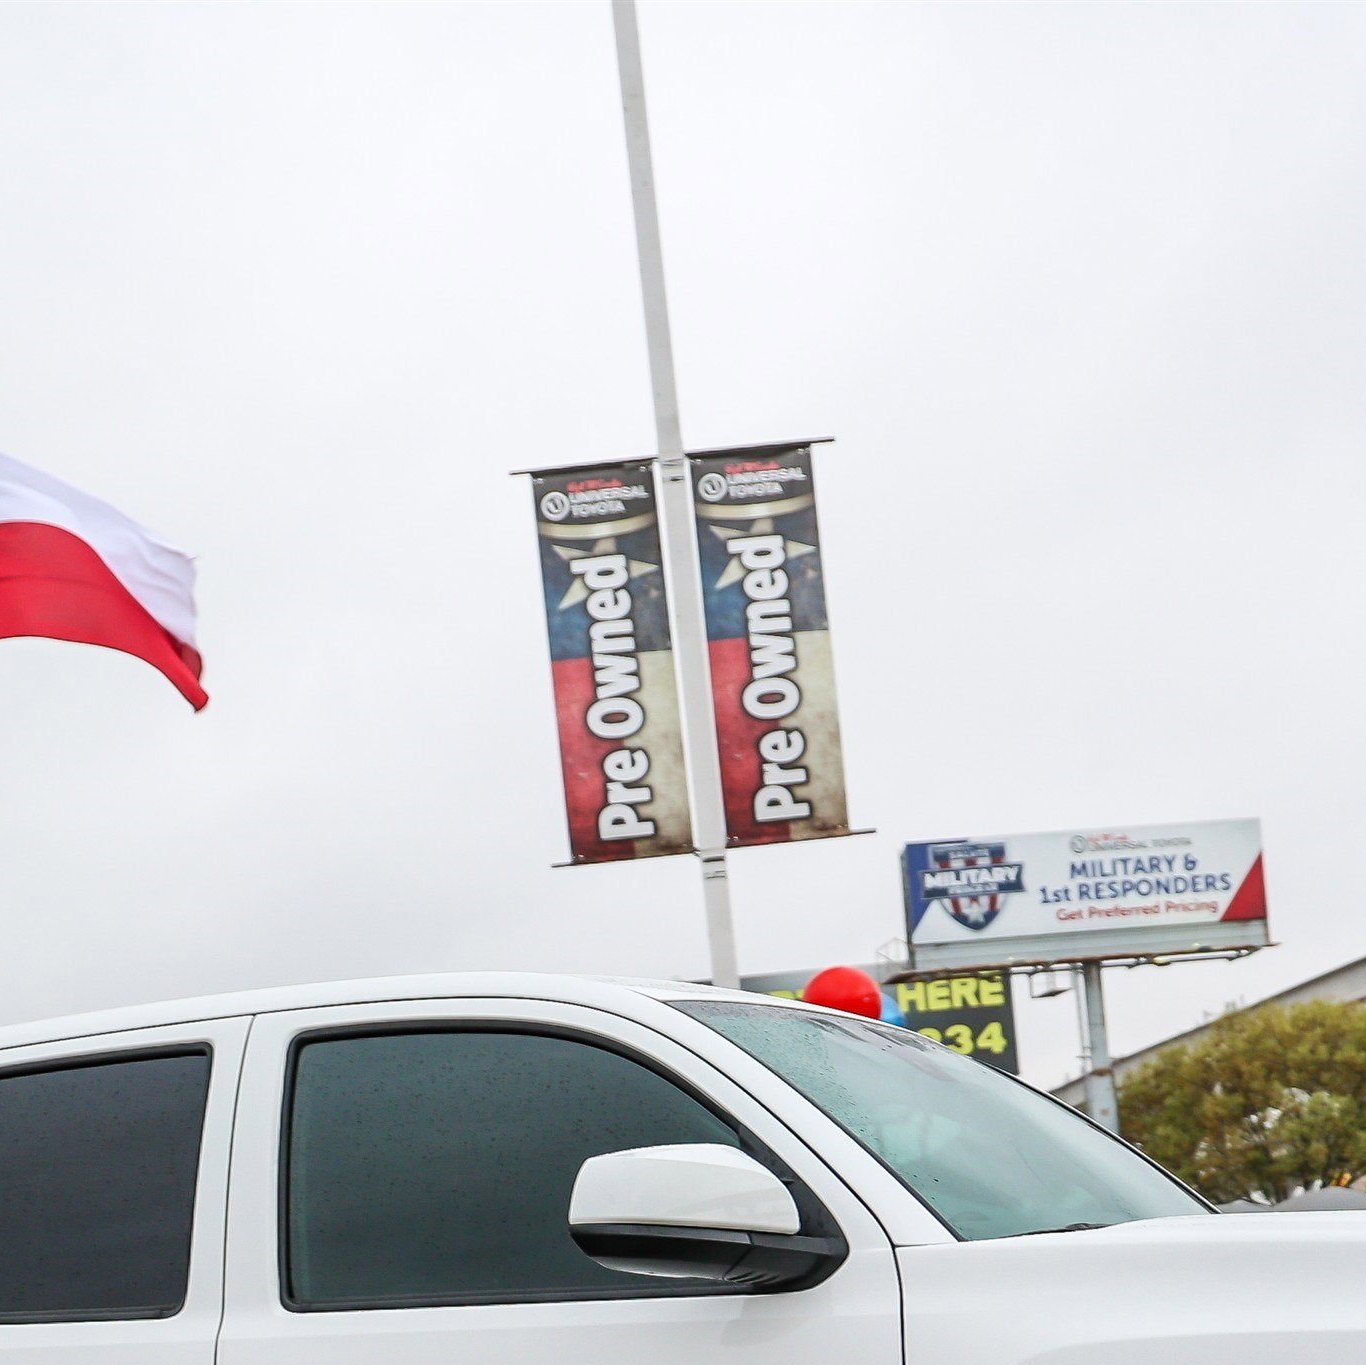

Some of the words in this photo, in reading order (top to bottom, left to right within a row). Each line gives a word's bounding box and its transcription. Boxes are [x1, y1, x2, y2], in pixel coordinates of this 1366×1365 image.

[569, 554, 645, 739] Owned
[726, 534, 800, 720] Owned
[598, 747, 656, 840] Pre
[754, 729, 811, 823] Pre
[923, 866, 1019, 889] MILITARY
[1070, 855, 1176, 879] MILITARY
[1039, 885, 1071, 904] 1st
[1078, 873, 1232, 900] RESPONDERS
[1056, 908, 1083, 921] Get
[896, 972, 1006, 1013] HERE
